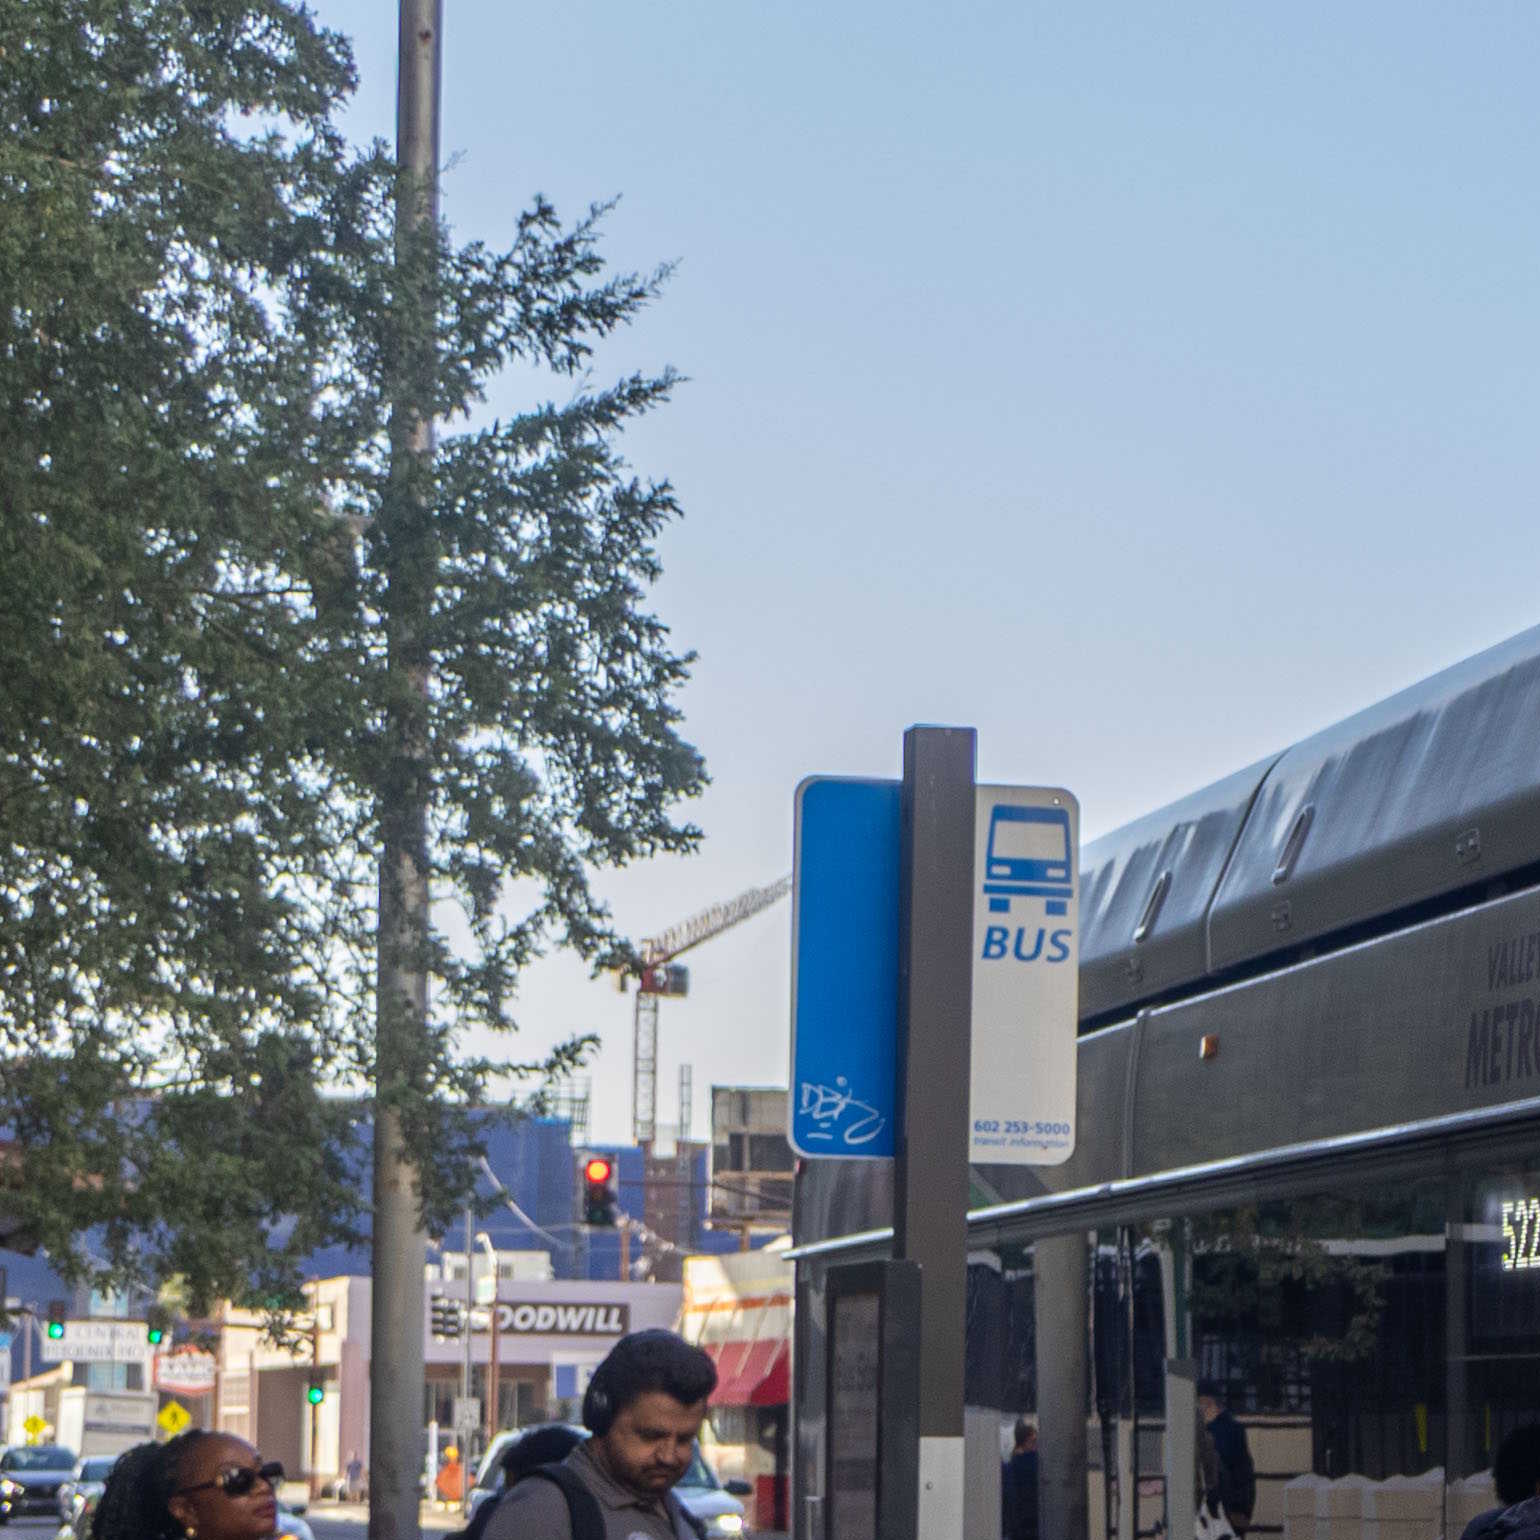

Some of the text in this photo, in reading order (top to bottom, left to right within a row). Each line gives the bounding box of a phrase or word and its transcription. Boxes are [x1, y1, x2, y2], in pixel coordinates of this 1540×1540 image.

[982, 926, 1072, 962] BUS
[974, 1120, 1070, 1135] 602 253-5000
[466, 1304, 622, 1332] OODWILL
